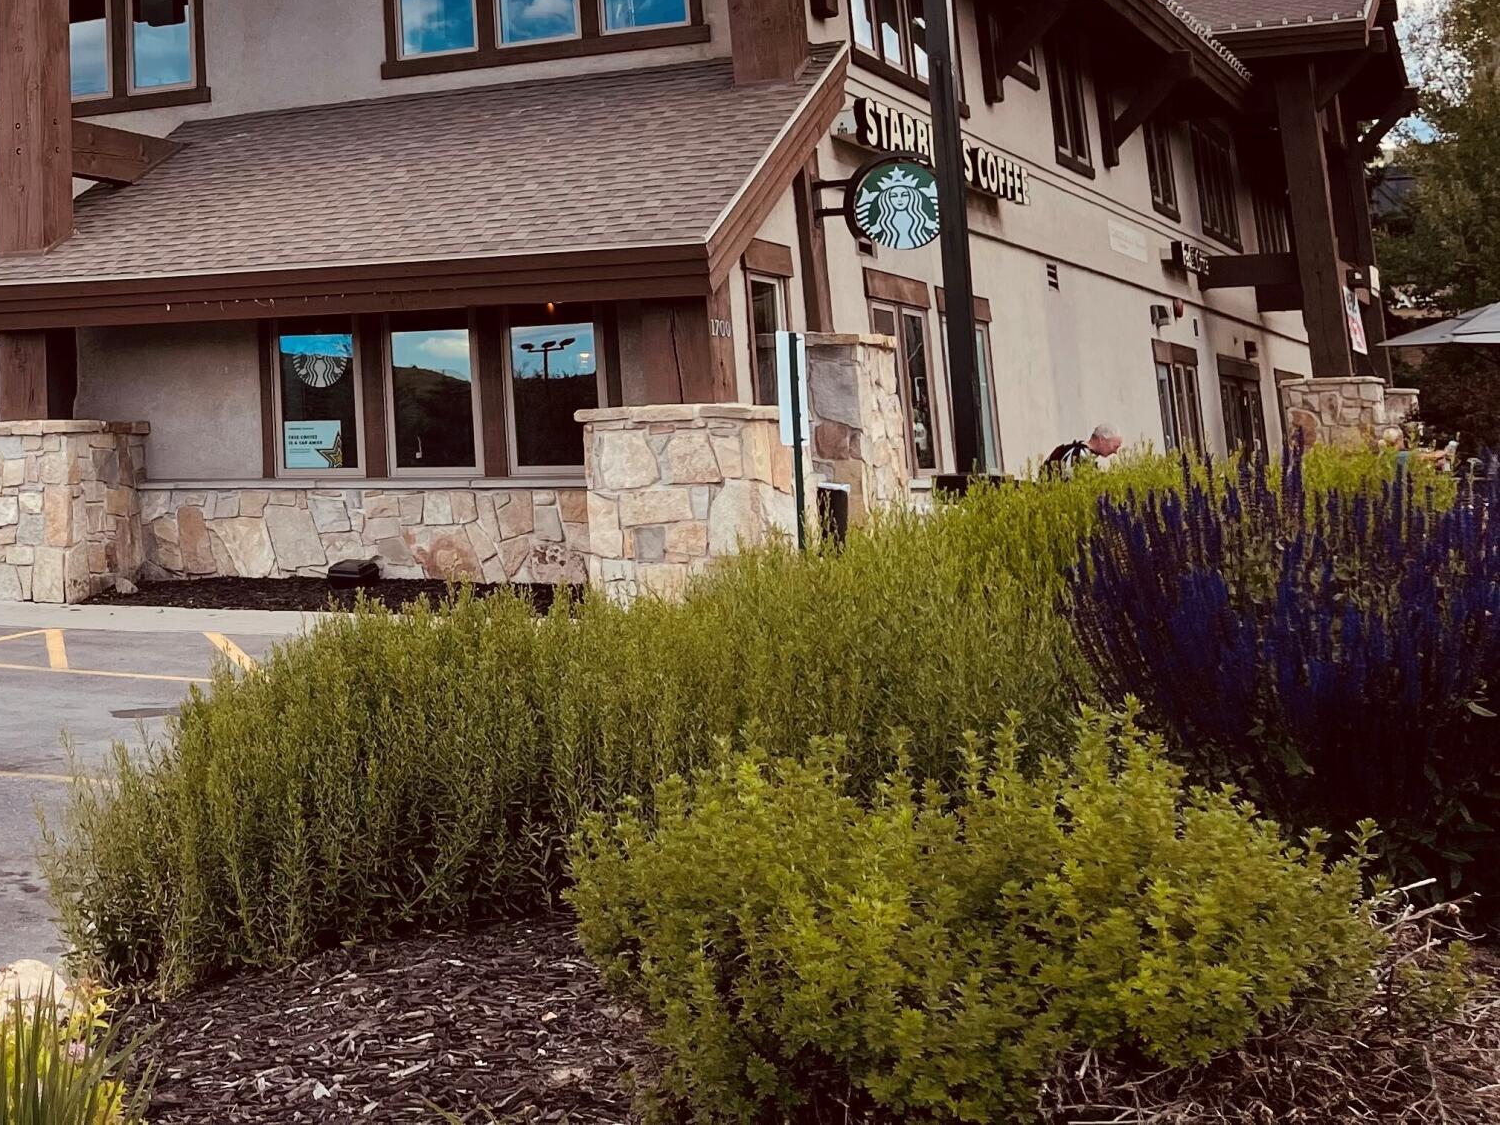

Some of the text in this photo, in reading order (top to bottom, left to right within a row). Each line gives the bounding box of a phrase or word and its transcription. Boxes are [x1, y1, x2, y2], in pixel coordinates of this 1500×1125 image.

[865, 97, 1030, 206] STARBS COFFEE
[710, 319, 731, 338] 1700
